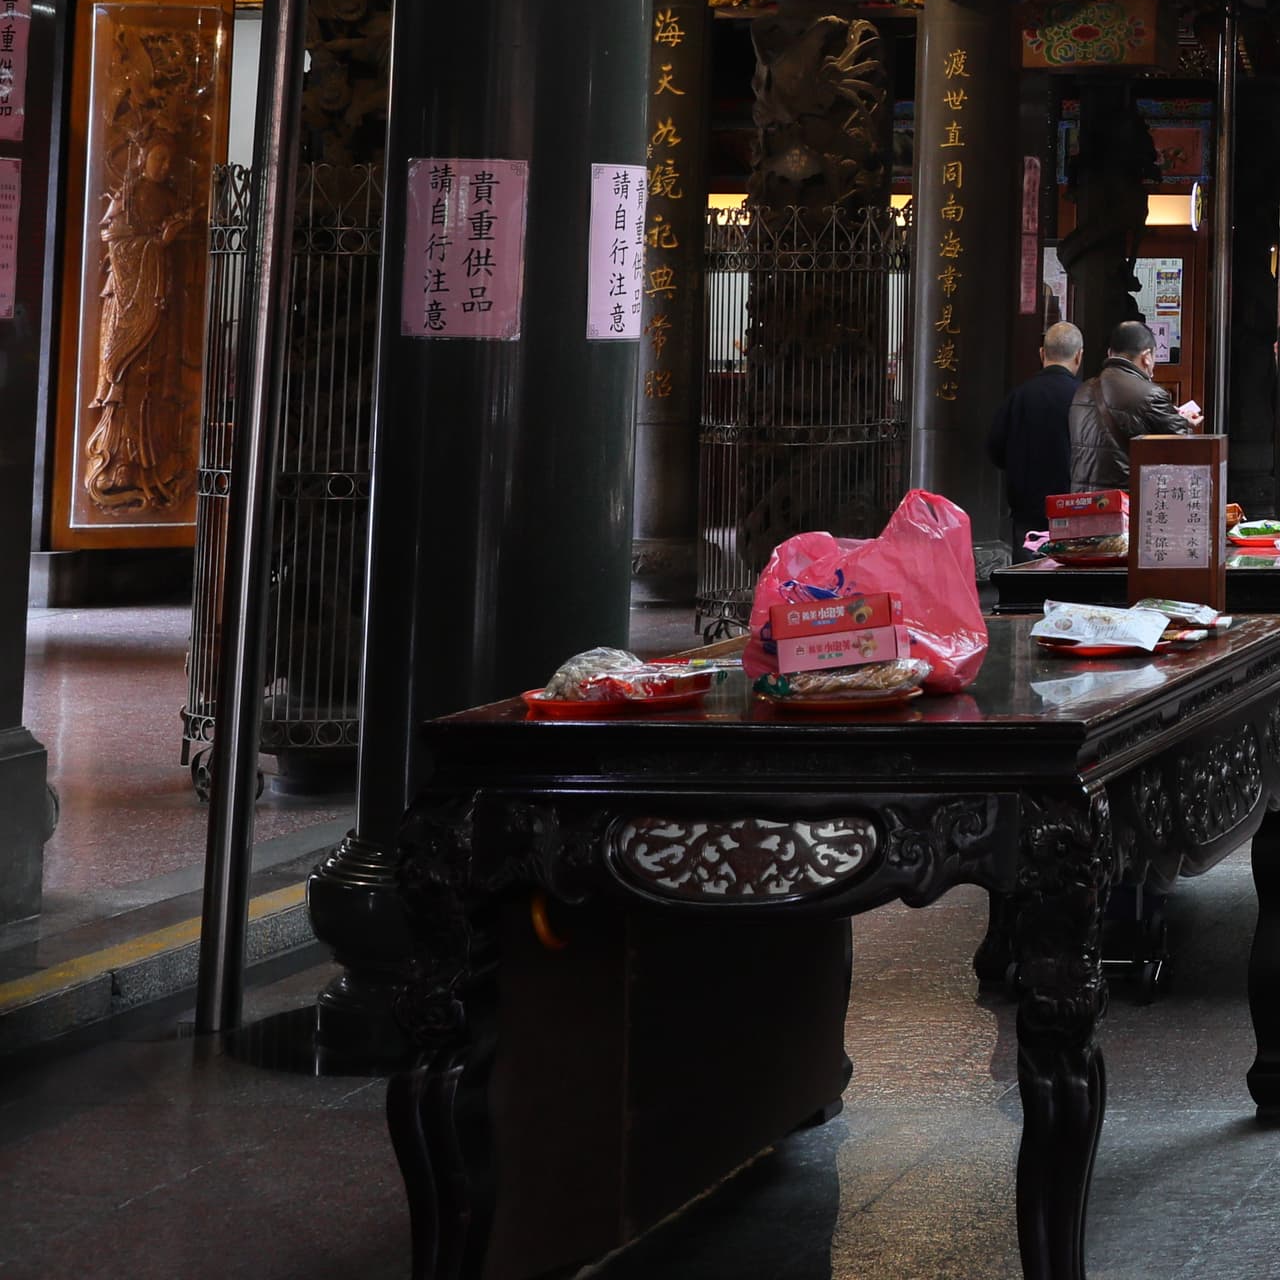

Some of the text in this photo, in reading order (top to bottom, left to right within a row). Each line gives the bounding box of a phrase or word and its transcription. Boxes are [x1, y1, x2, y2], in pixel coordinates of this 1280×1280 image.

[423, 164, 456, 331] 請自行注意
[461, 171, 500, 313] 貴重供品
[608, 170, 631, 333] 請自行注意
